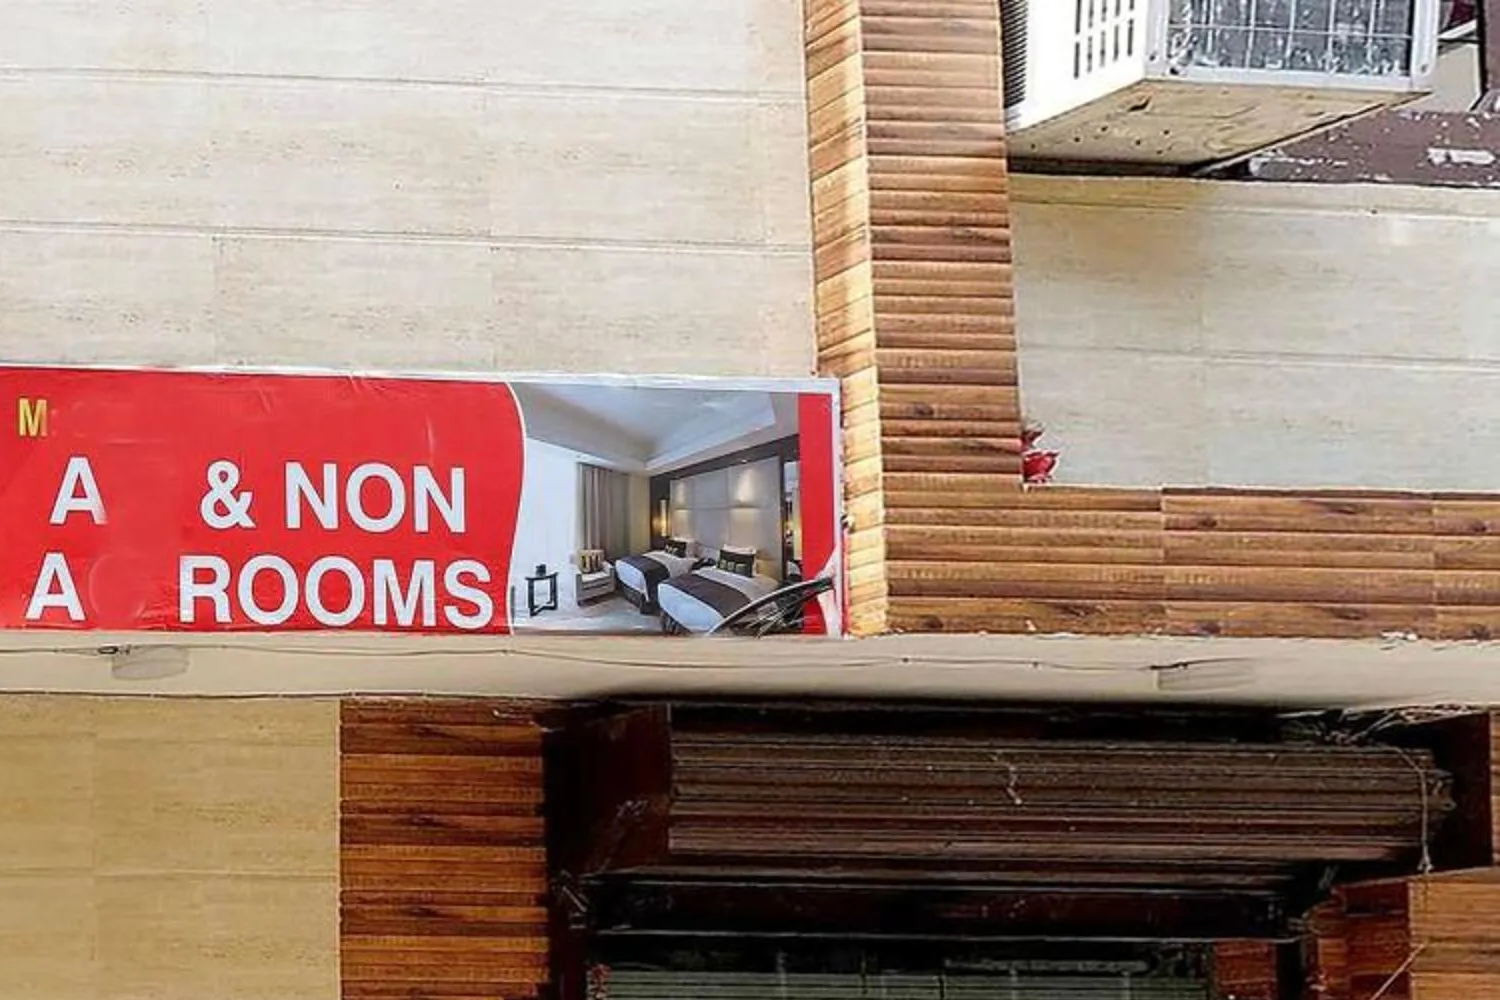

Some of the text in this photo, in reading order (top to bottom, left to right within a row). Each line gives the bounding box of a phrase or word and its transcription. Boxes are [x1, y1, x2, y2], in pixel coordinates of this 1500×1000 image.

[199, 459, 256, 530] &
[284, 460, 467, 534] NON
[178, 554, 496, 631] ROOMS
